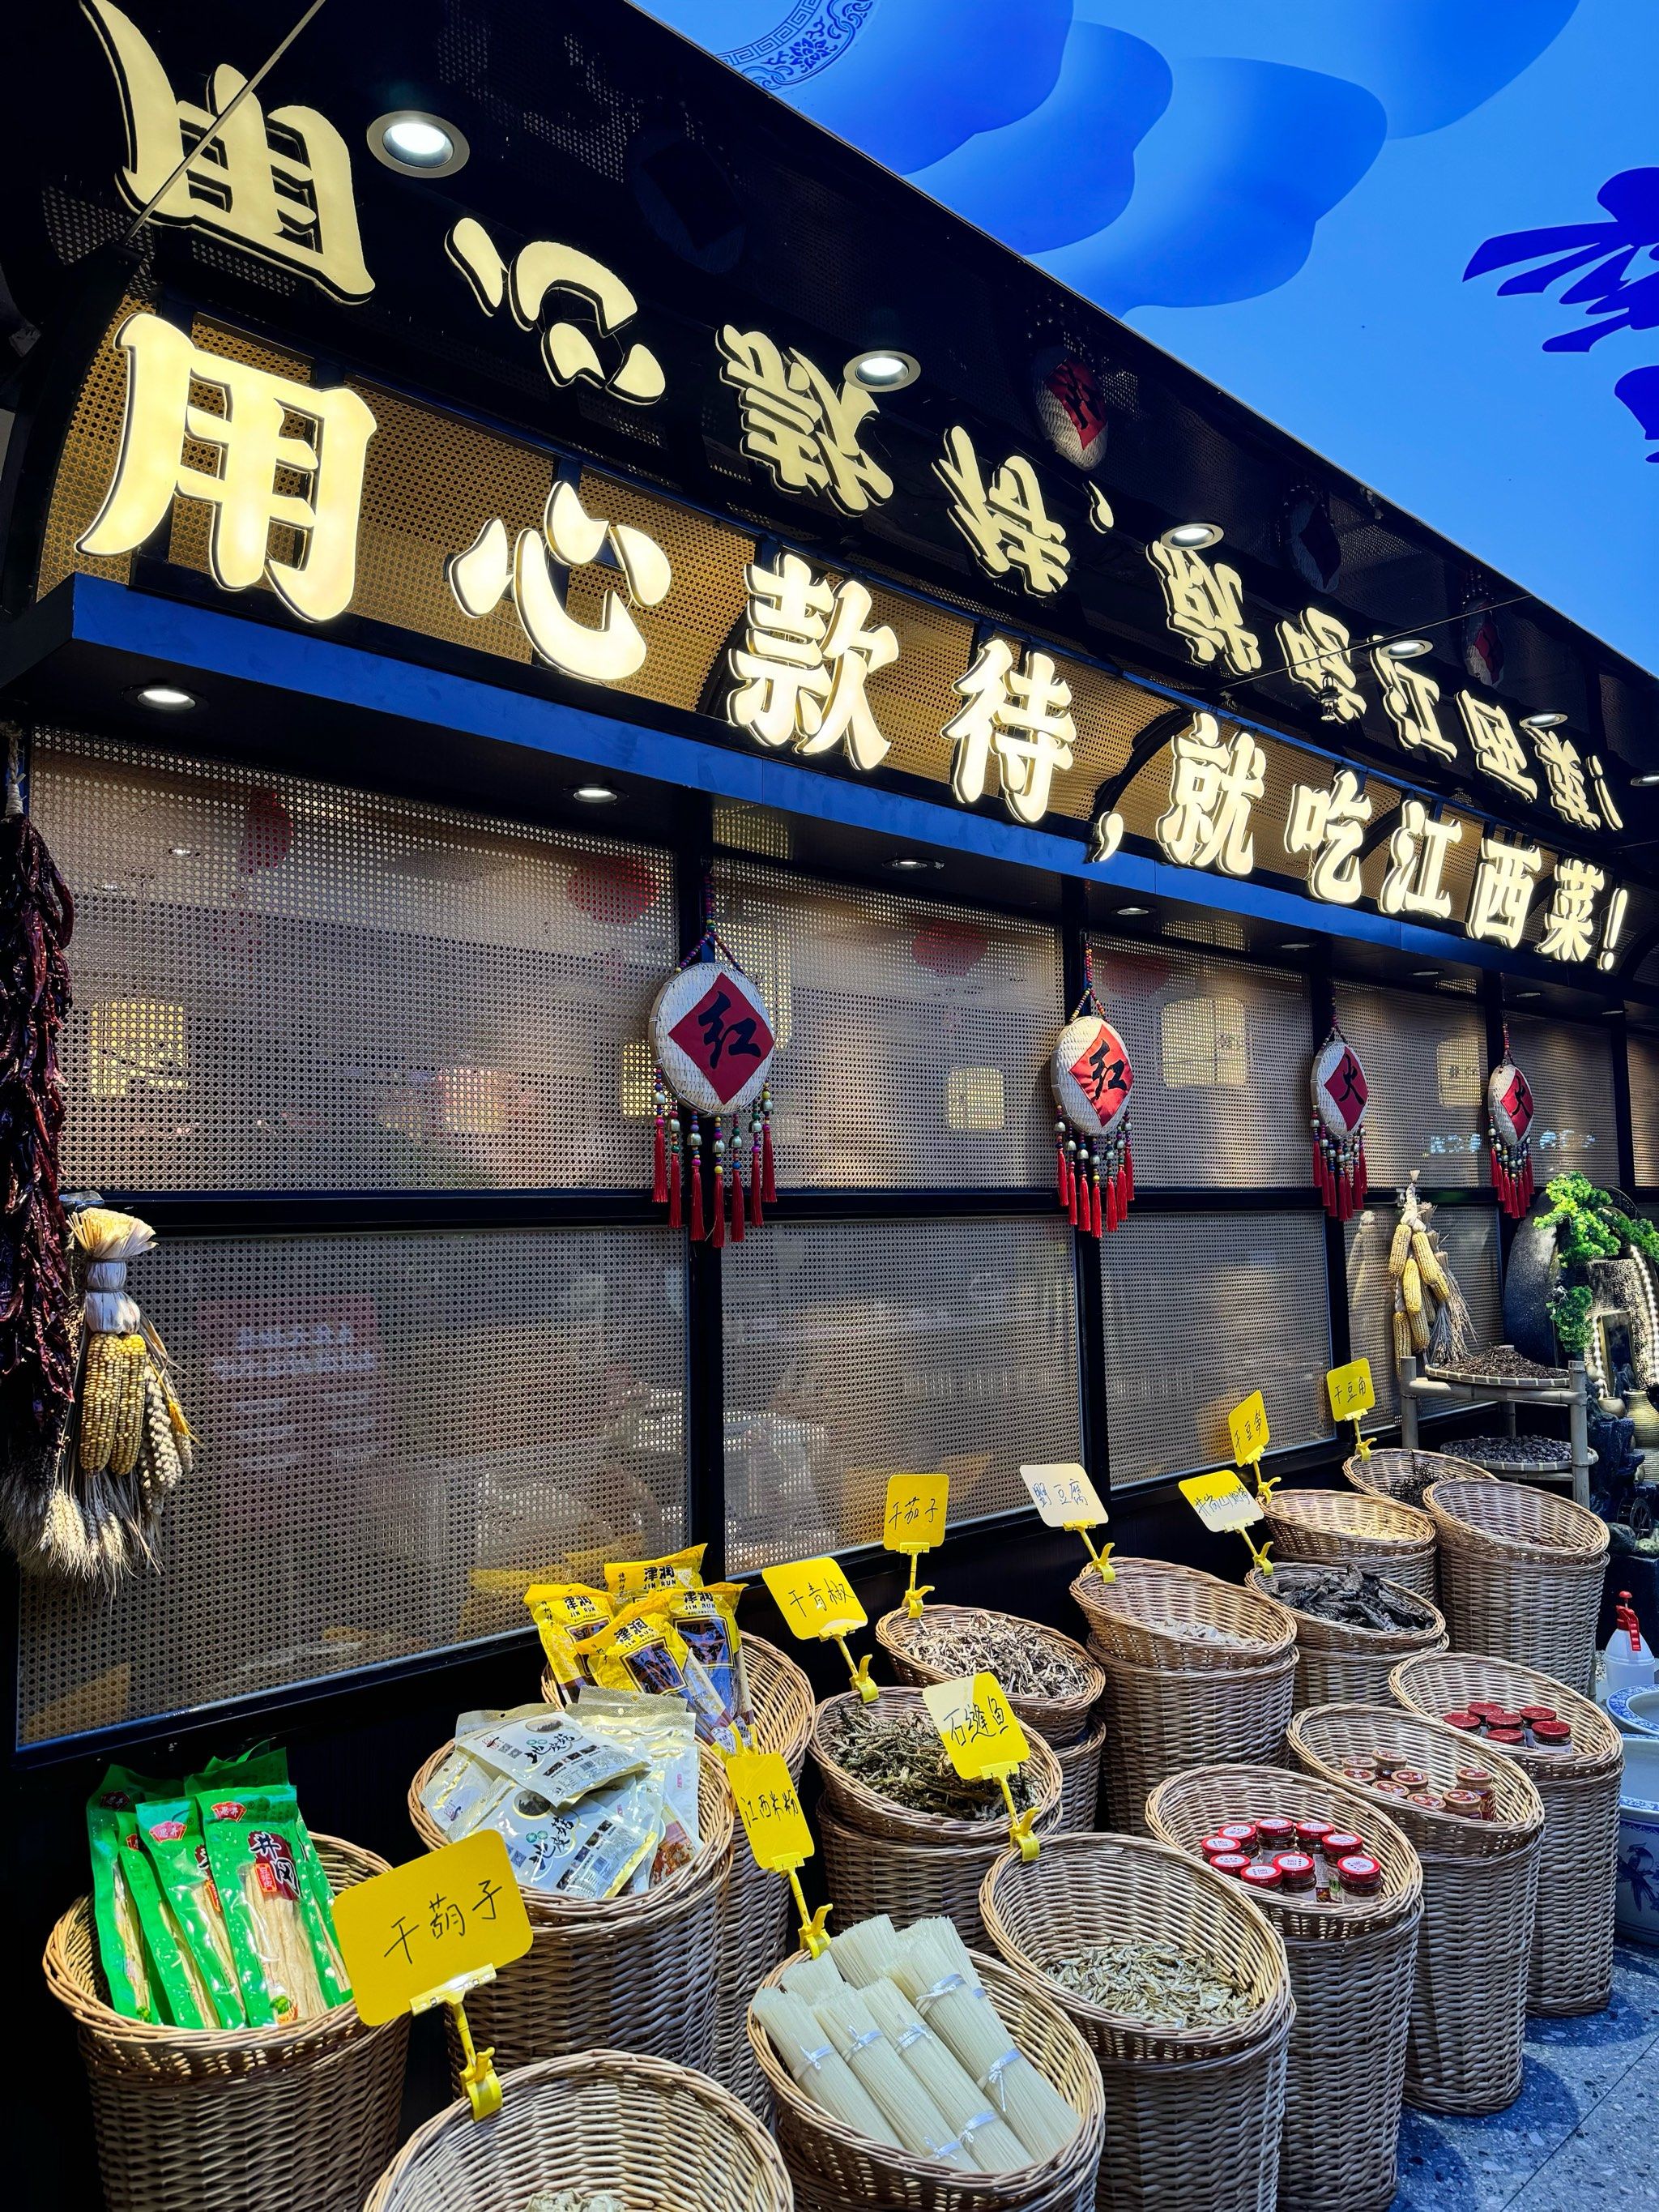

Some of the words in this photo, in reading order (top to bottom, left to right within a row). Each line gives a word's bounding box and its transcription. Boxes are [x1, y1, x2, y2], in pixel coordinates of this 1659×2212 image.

[75, 312, 1628, 971] 用心款待，就吃江西菜！
[697, 990, 762, 1070] 红
[1088, 1040, 1127, 1100] 红
[1338, 1053, 1365, 1105] 火
[1512, 1075, 1533, 1119] 火
[1333, 1376, 1367, 1404] 干豆角
[888, 1497, 939, 1530] 干茄子
[661, 1579, 676, 1587] RUN
[788, 1578, 855, 1618] 干青椒
[943, 1695, 1009, 1747] 石缝鱼
[740, 1788, 799, 1829] 江西米粉
